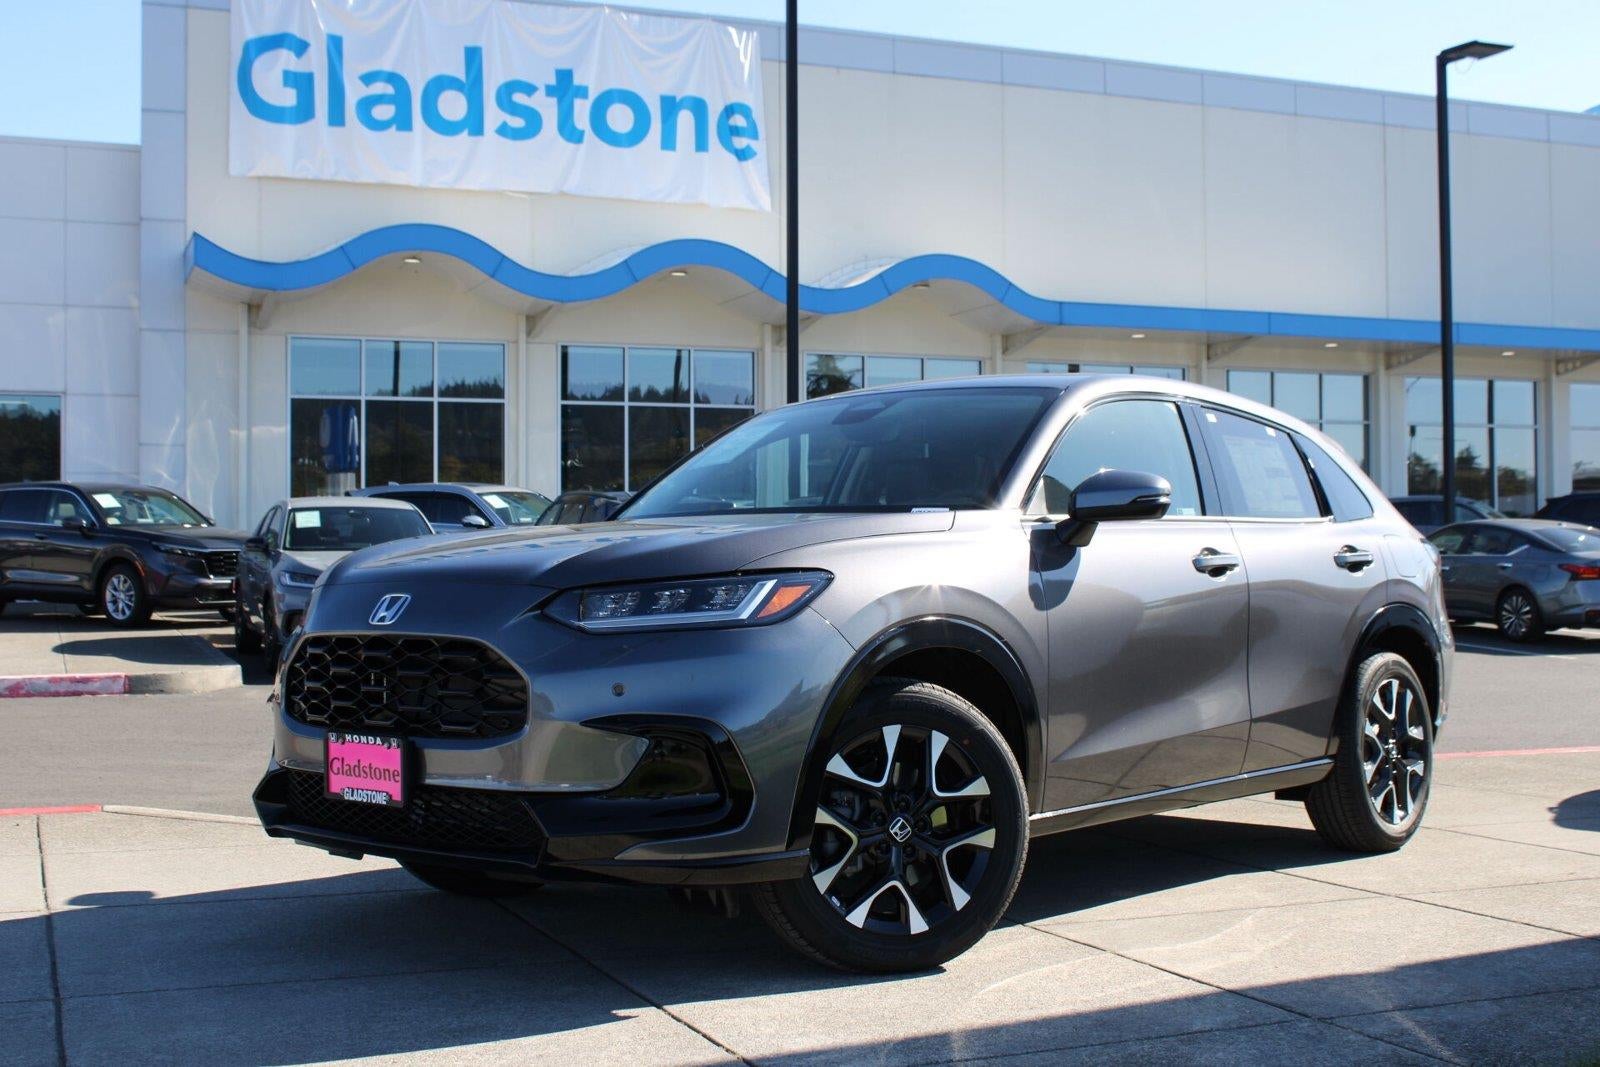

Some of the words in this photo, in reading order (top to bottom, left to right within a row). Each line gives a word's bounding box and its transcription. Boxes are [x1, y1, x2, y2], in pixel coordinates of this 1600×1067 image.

[237, 32, 760, 162] Gladstone
[345, 734, 382, 745] HONDA
[329, 757, 401, 783] Gladstone
[344, 787, 387, 804] GLADSTONE
